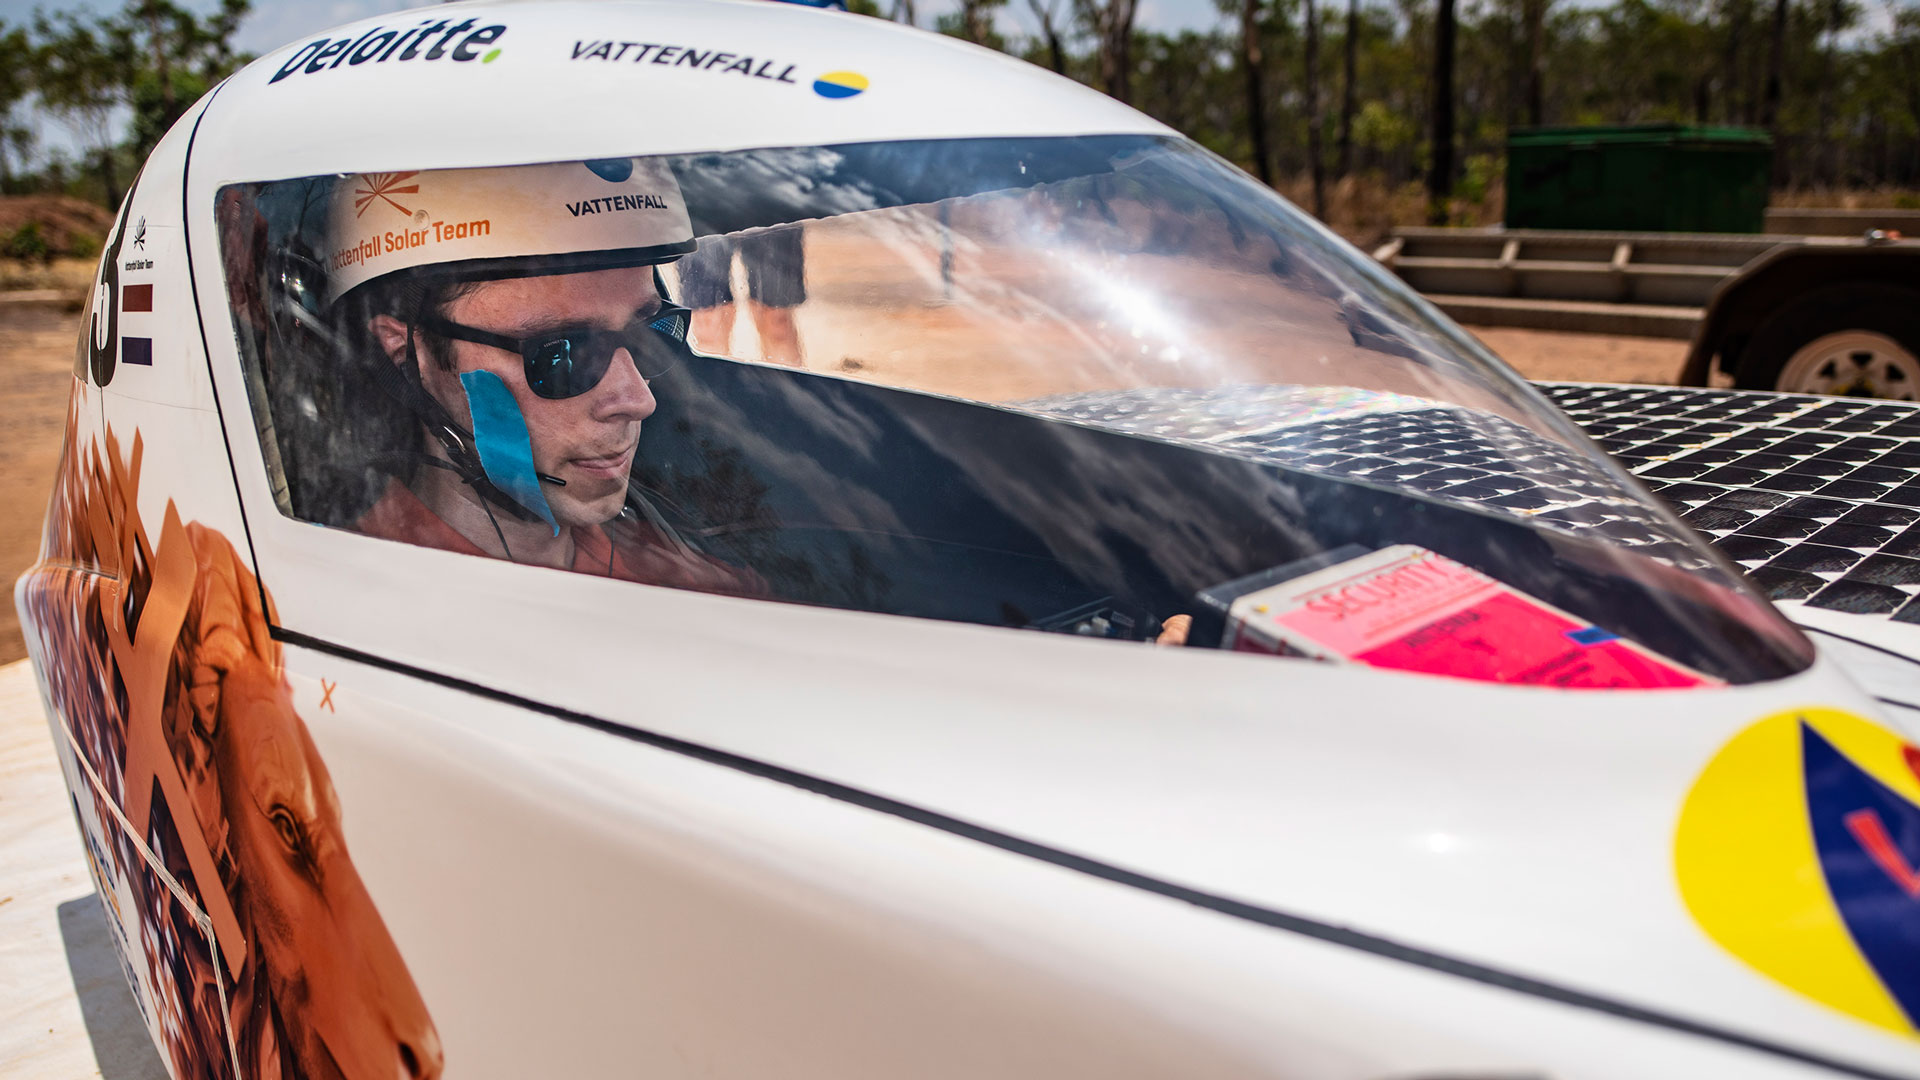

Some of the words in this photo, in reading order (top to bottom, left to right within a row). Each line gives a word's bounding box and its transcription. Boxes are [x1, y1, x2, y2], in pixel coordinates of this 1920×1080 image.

[268, 18, 507, 85] Deloitte.
[571, 41, 797, 84] VATTENFALL
[565, 194, 668, 217] VATTENFALL
[384, 228, 429, 253] Solar
[432, 219, 490, 243] Team
